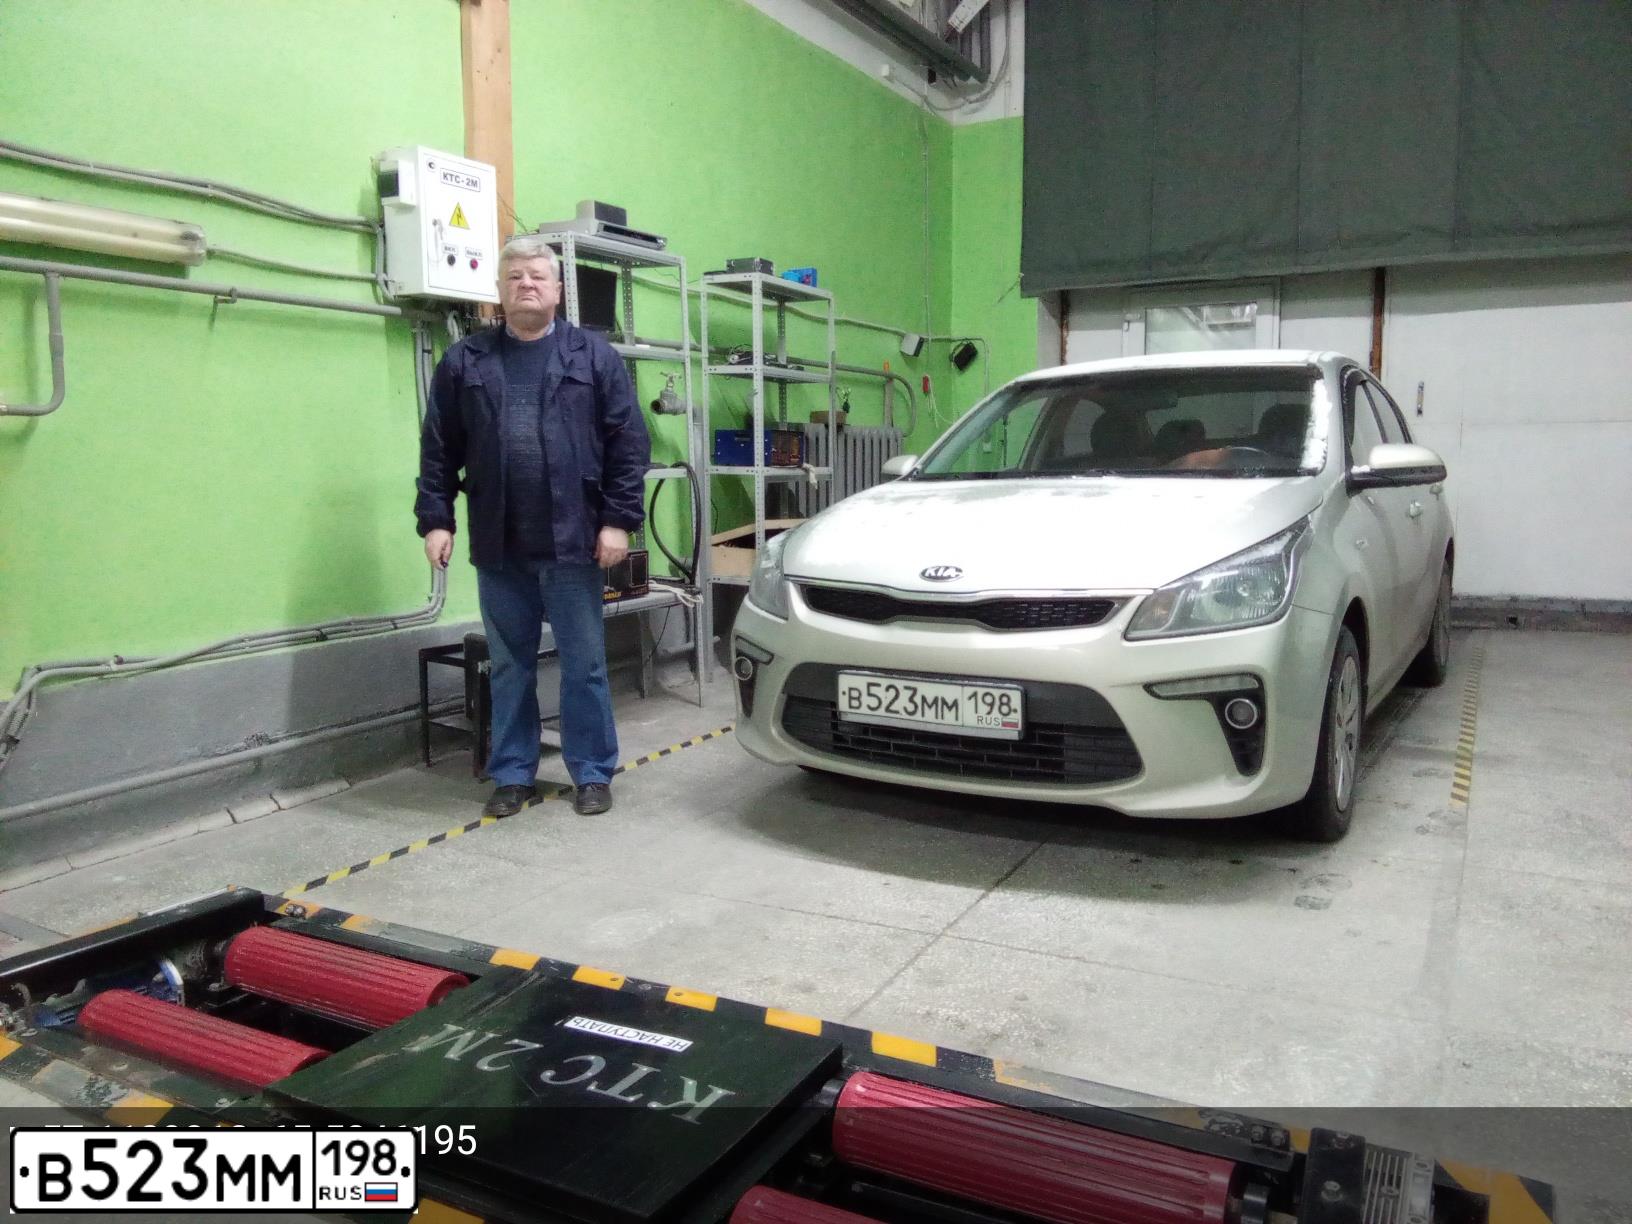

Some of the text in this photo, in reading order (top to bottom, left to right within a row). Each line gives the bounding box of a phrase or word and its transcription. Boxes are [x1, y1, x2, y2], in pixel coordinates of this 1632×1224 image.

[923, 566, 960, 579] KIA
[848, 682, 1012, 721] В523ММ 198
[976, 715, 1000, 726] RUS
[572, 1018, 690, 1050] НЕ НАСТУПАТЬ
